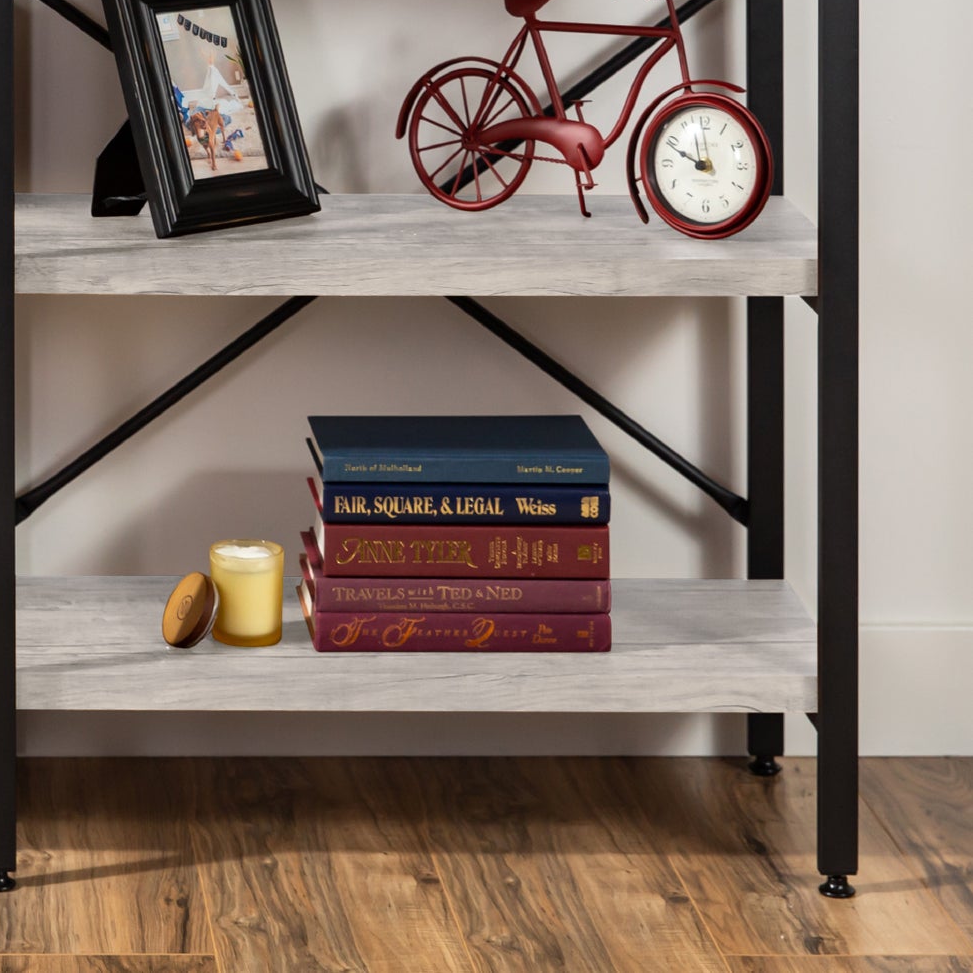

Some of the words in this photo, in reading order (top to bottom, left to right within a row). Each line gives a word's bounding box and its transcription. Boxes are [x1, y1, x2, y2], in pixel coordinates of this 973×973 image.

[333, 495, 372, 516] FAIR,
[373, 495, 438, 519] SQUARE,
[440, 495, 454, 515] &
[456, 496, 504, 516] LEGAL
[515, 497, 557, 516] Weiss
[336, 538, 407, 565] ANNE
[409, 539, 479, 568] TYLER
[331, 586, 405, 602] TRAVELS
[407, 586, 434, 596] with
[436, 585, 473, 601] TED
[475, 588, 484, 599] &
[485, 585, 523, 601] NED
